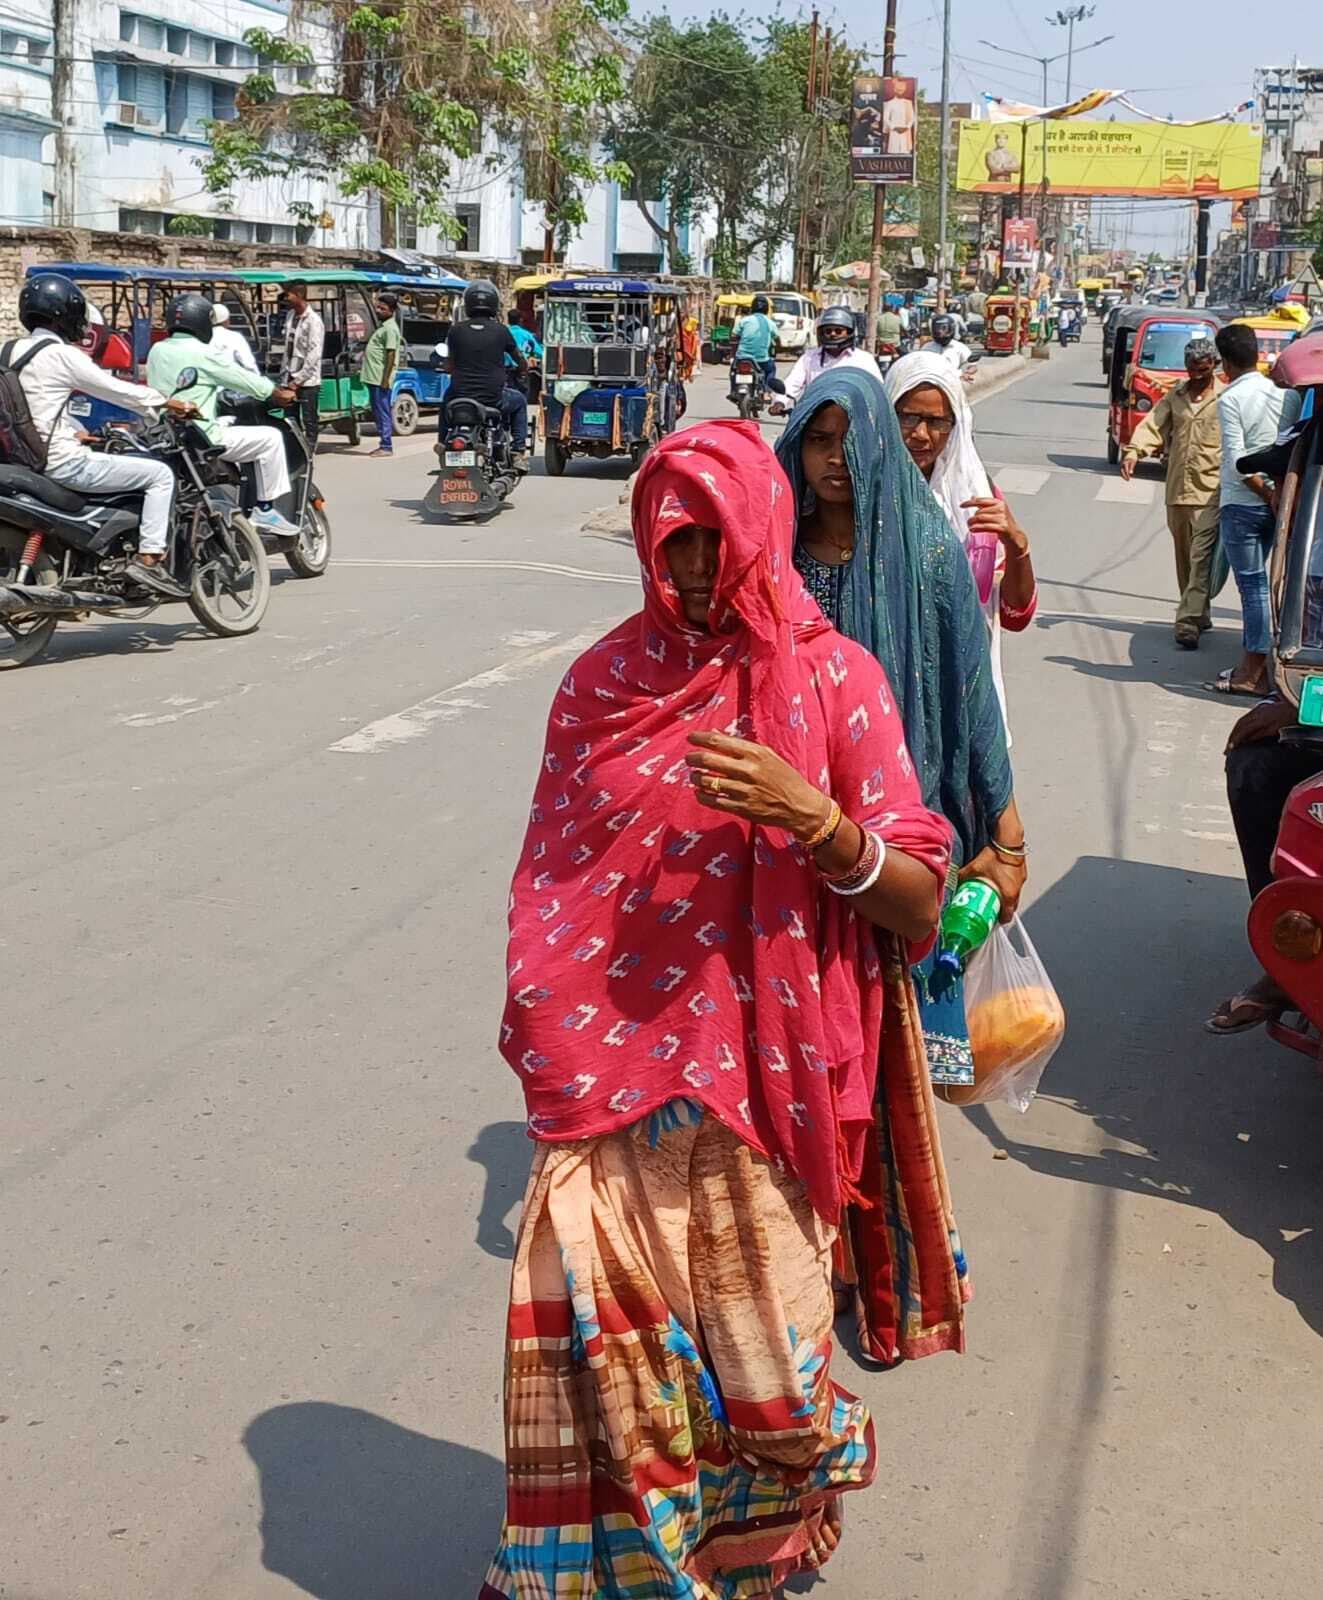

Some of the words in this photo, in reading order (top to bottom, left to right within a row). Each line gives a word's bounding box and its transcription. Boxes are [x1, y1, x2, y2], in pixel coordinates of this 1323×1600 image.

[573, 280, 624, 292] सारथी
[442, 479, 473, 492] ROYAL
[440, 491, 479, 505] ENFIELD
